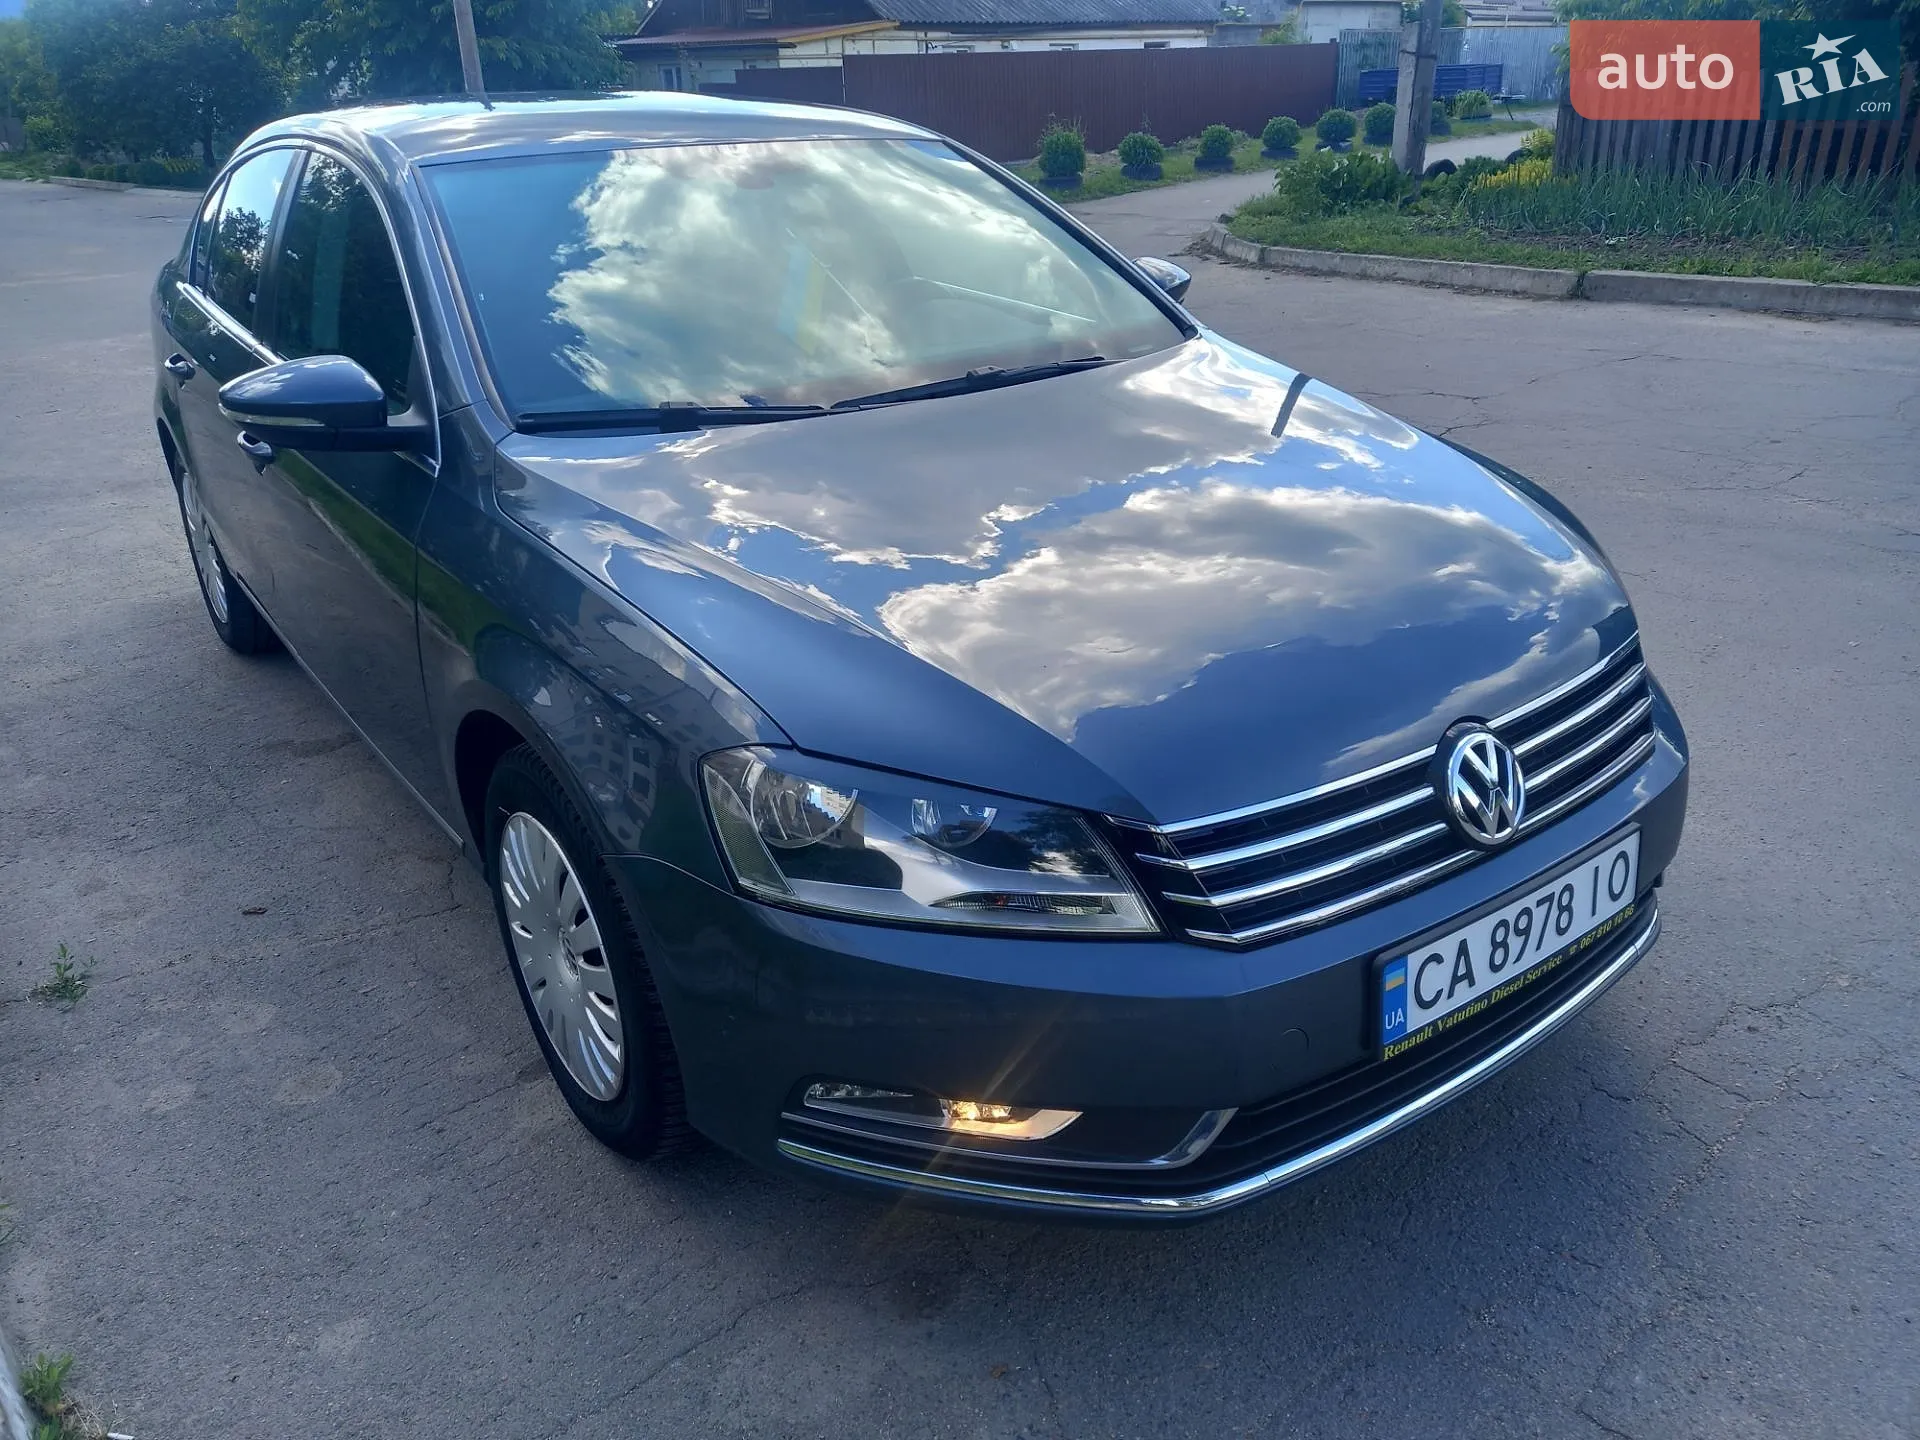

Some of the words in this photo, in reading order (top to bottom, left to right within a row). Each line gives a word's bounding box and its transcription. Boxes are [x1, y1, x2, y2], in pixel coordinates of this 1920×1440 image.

[1414, 938, 1477, 1010] CA
[1489, 883, 1575, 973] 8978
[1591, 850, 1630, 918] IO
[1383, 1025, 1433, 1061] Renault
[1437, 998, 1488, 1032] Vatutino
[1491, 975, 1525, 1004] Diesel
[1525, 955, 1562, 984] Service
[1385, 1007, 1405, 1030] UA
